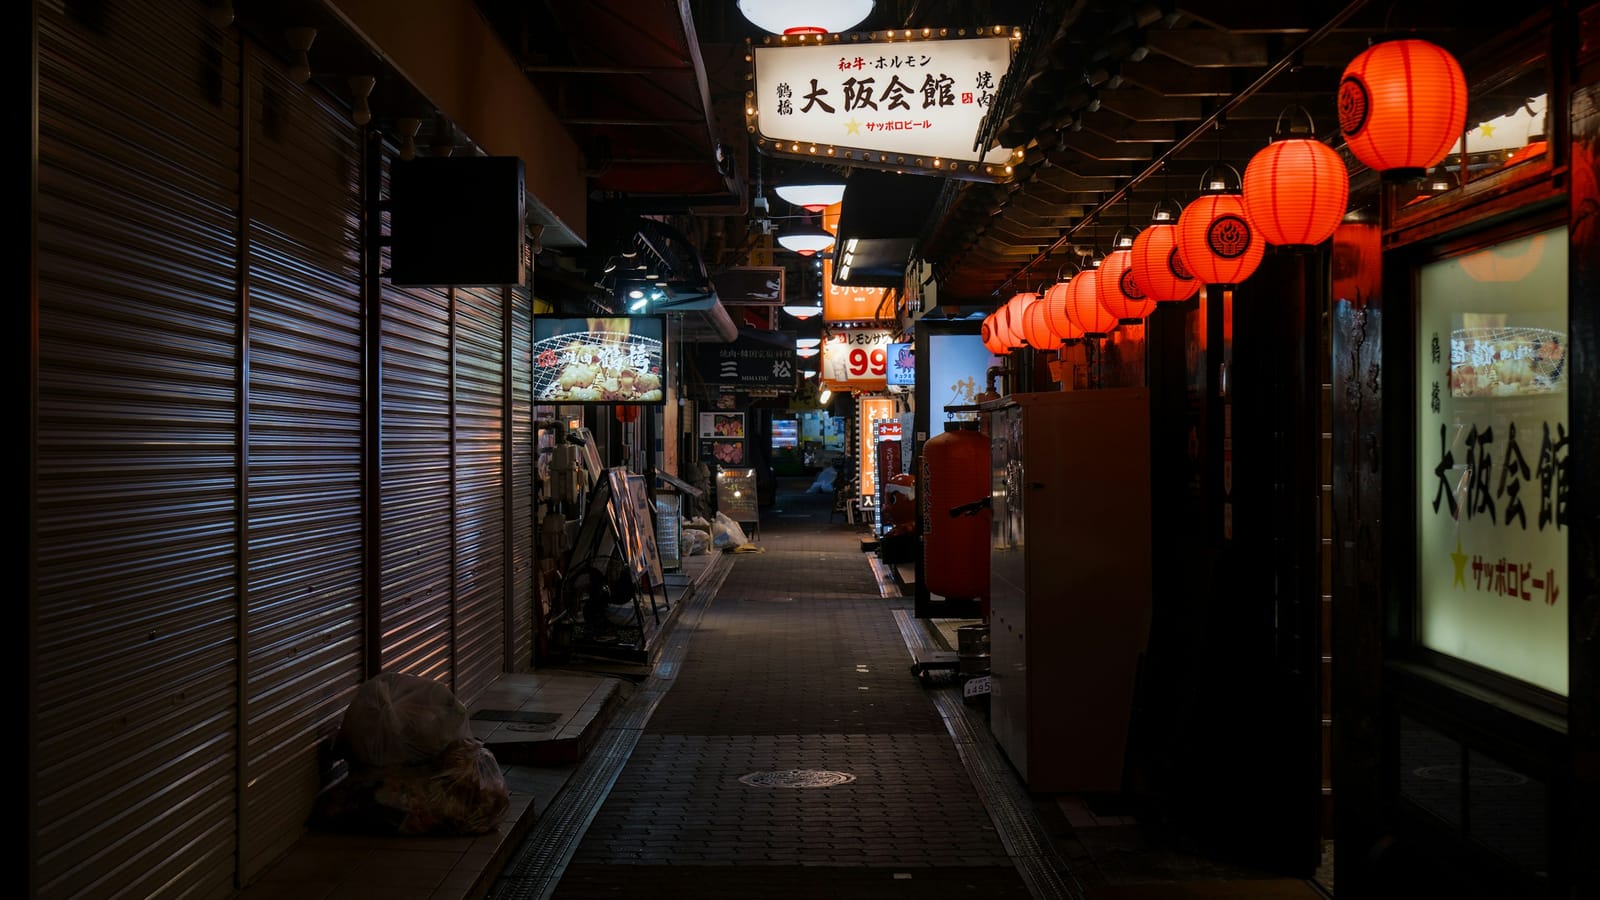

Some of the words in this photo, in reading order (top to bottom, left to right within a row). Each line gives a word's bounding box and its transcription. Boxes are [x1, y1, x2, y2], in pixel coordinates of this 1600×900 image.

[838, 55, 932, 72] 和牛・ホルモン
[776, 82, 793, 116] 鶴橋
[800, 73, 956, 114] 大阪会館
[975, 71, 994, 109] 焼肉
[866, 119, 932, 132] サッポロビール
[1433, 421, 1569, 532] 大阪会館
[1471, 554, 1560, 606] サッポロビール
